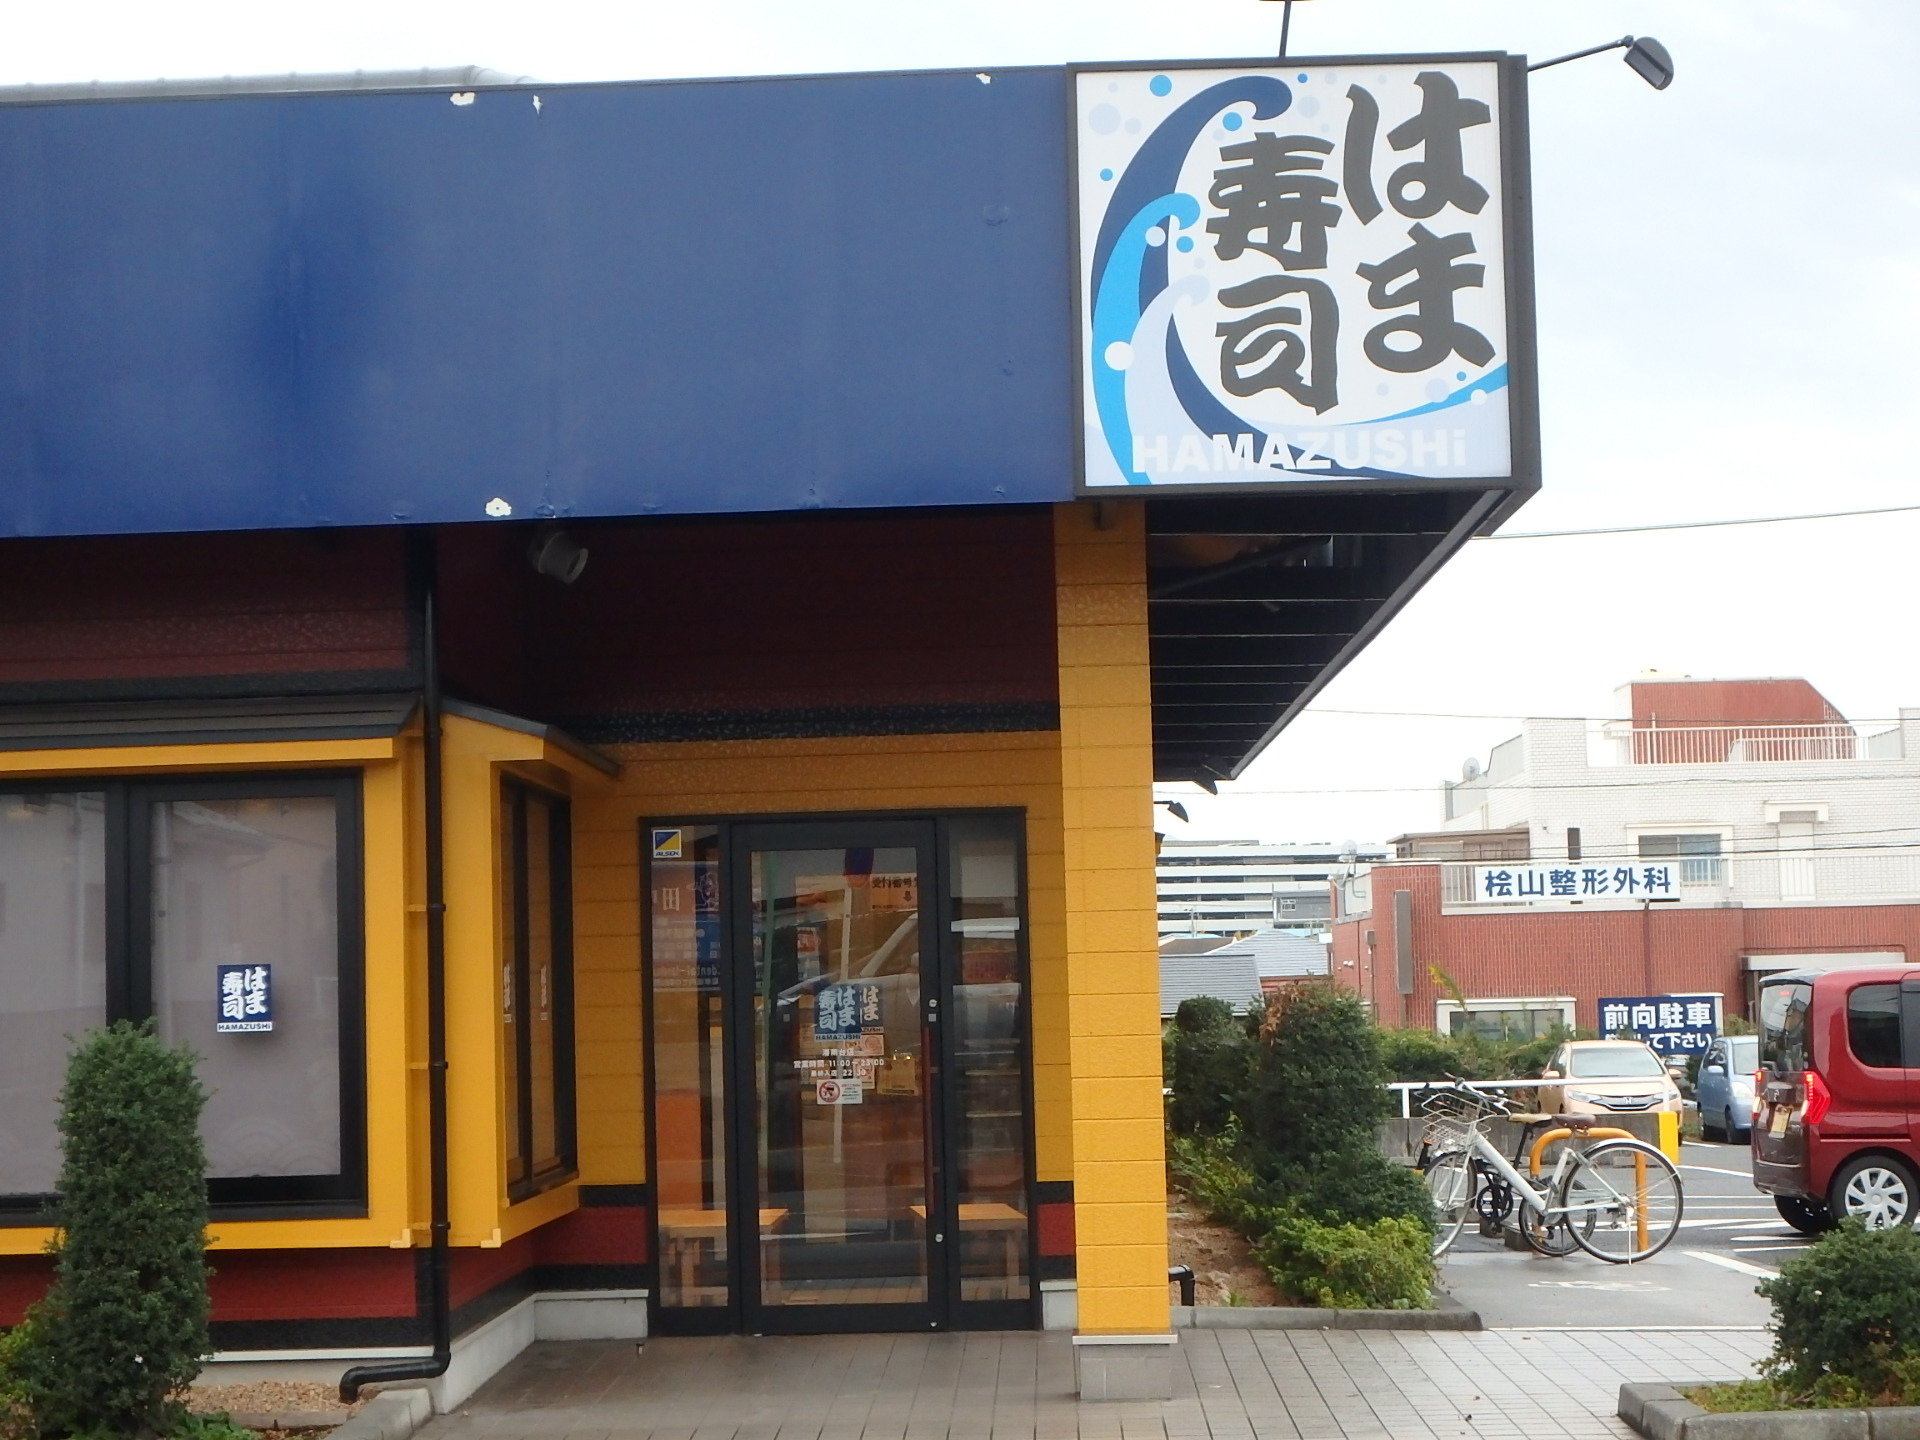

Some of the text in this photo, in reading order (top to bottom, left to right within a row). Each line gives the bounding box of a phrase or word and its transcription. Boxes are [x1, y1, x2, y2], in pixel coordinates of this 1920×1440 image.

[1342, 70, 1497, 374] はま
[1204, 131, 1343, 416] 寿司
[1484, 866, 1672, 898] 桧山整形外科
[222, 971, 244, 1021] 寿司
[244, 966, 267, 1014] はま
[818, 990, 838, 1032] 寿司
[837, 985, 857, 1027] はま
[1603, 1002, 1713, 1031] 前向駐車
